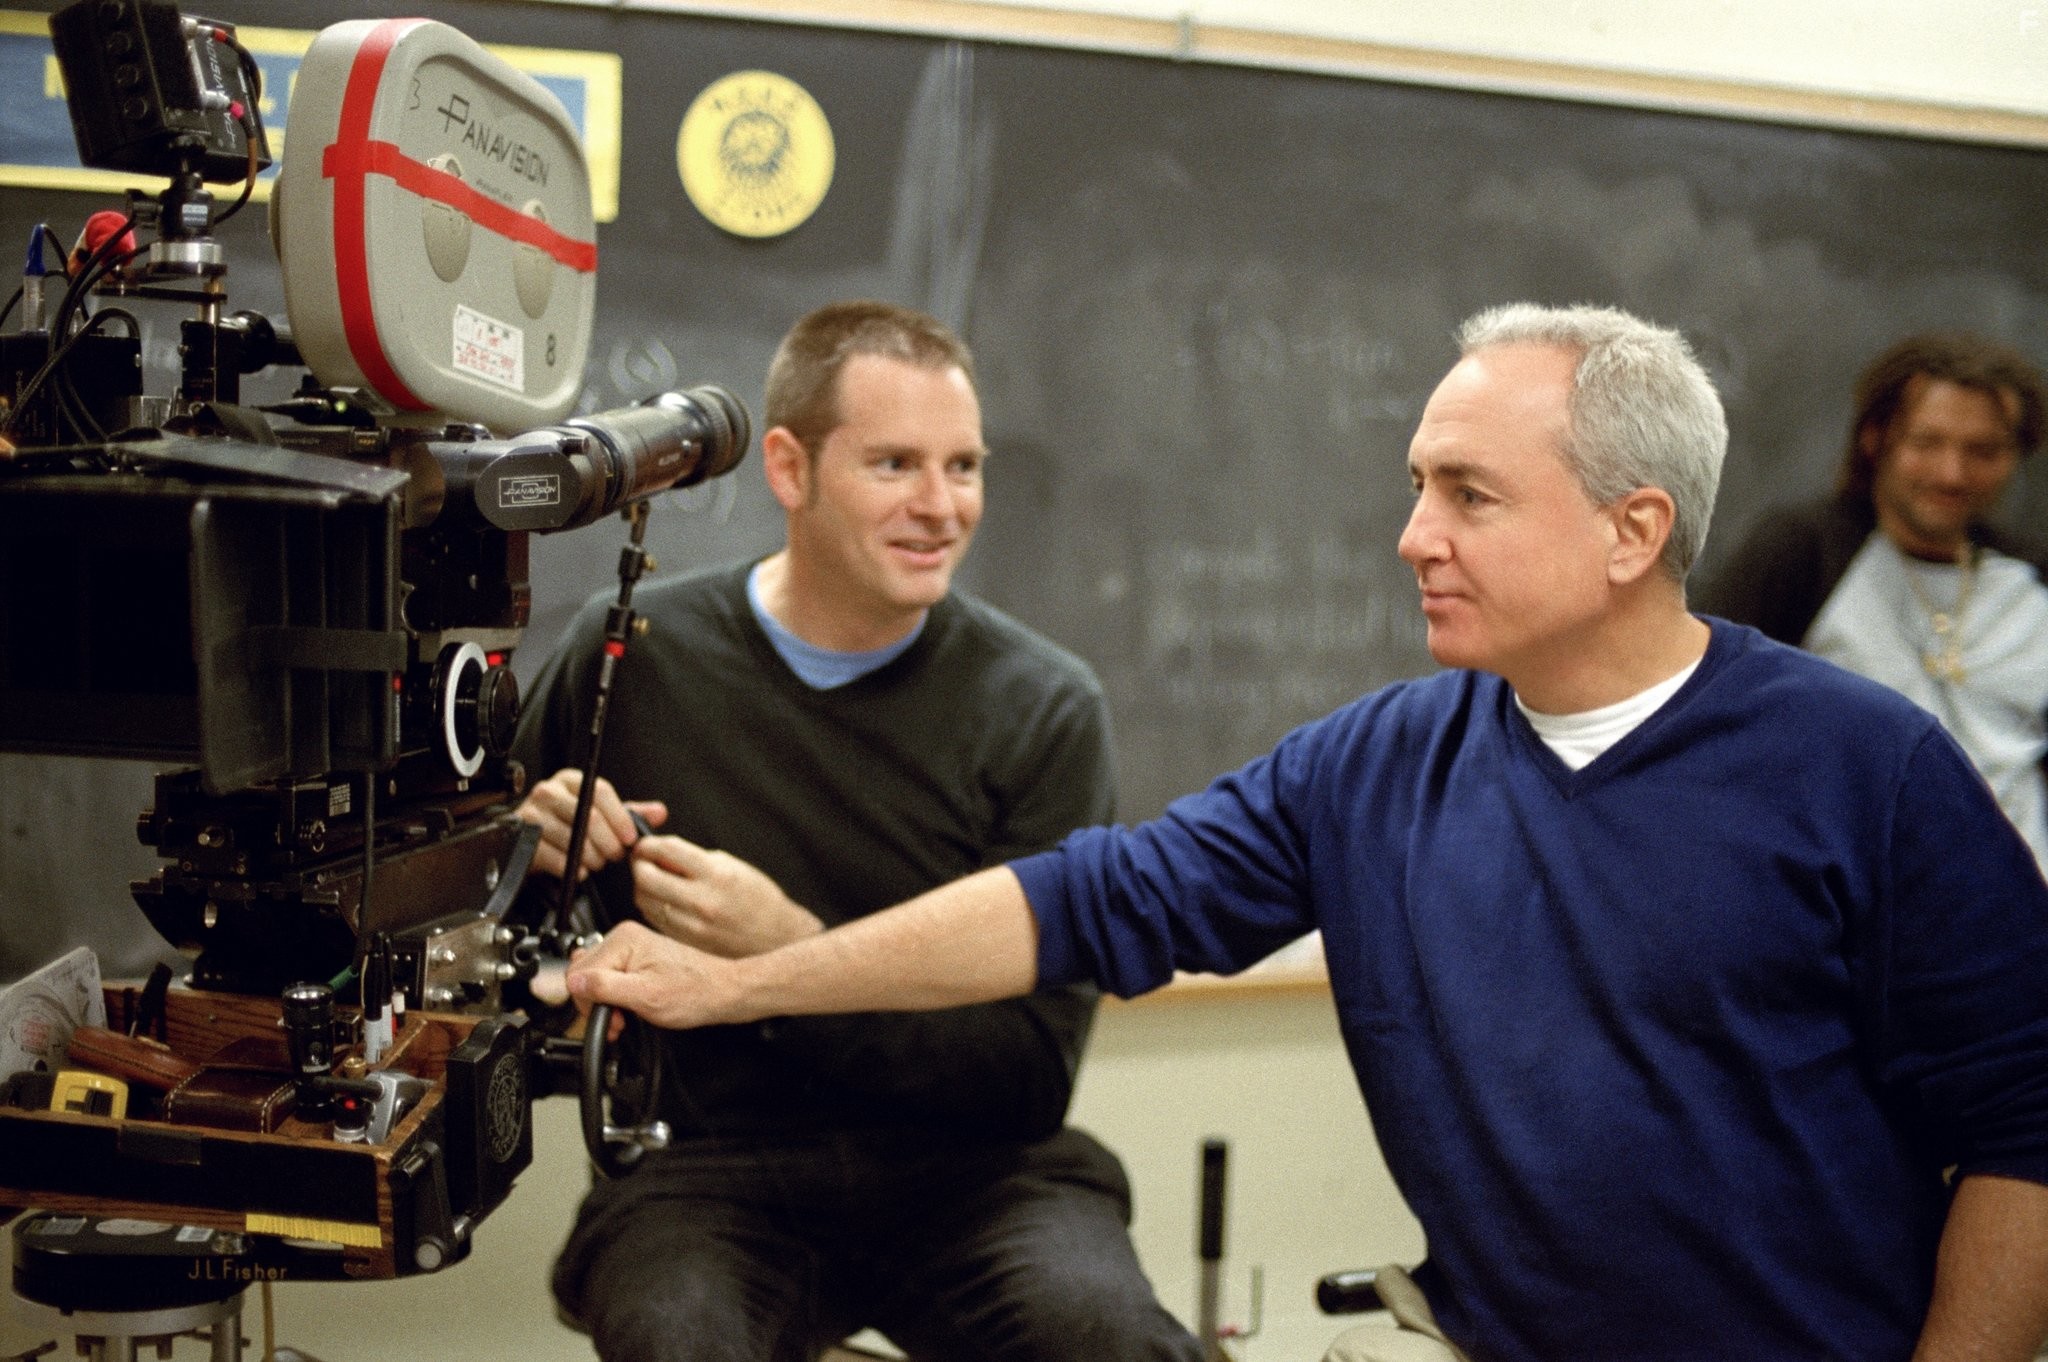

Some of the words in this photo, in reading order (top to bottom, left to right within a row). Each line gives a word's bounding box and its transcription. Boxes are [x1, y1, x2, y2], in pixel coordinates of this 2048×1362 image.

[438, 94, 549, 187] PANAVISION
[545, 333, 557, 367] 8
[223, 1259, 287, 1280] Fisher
